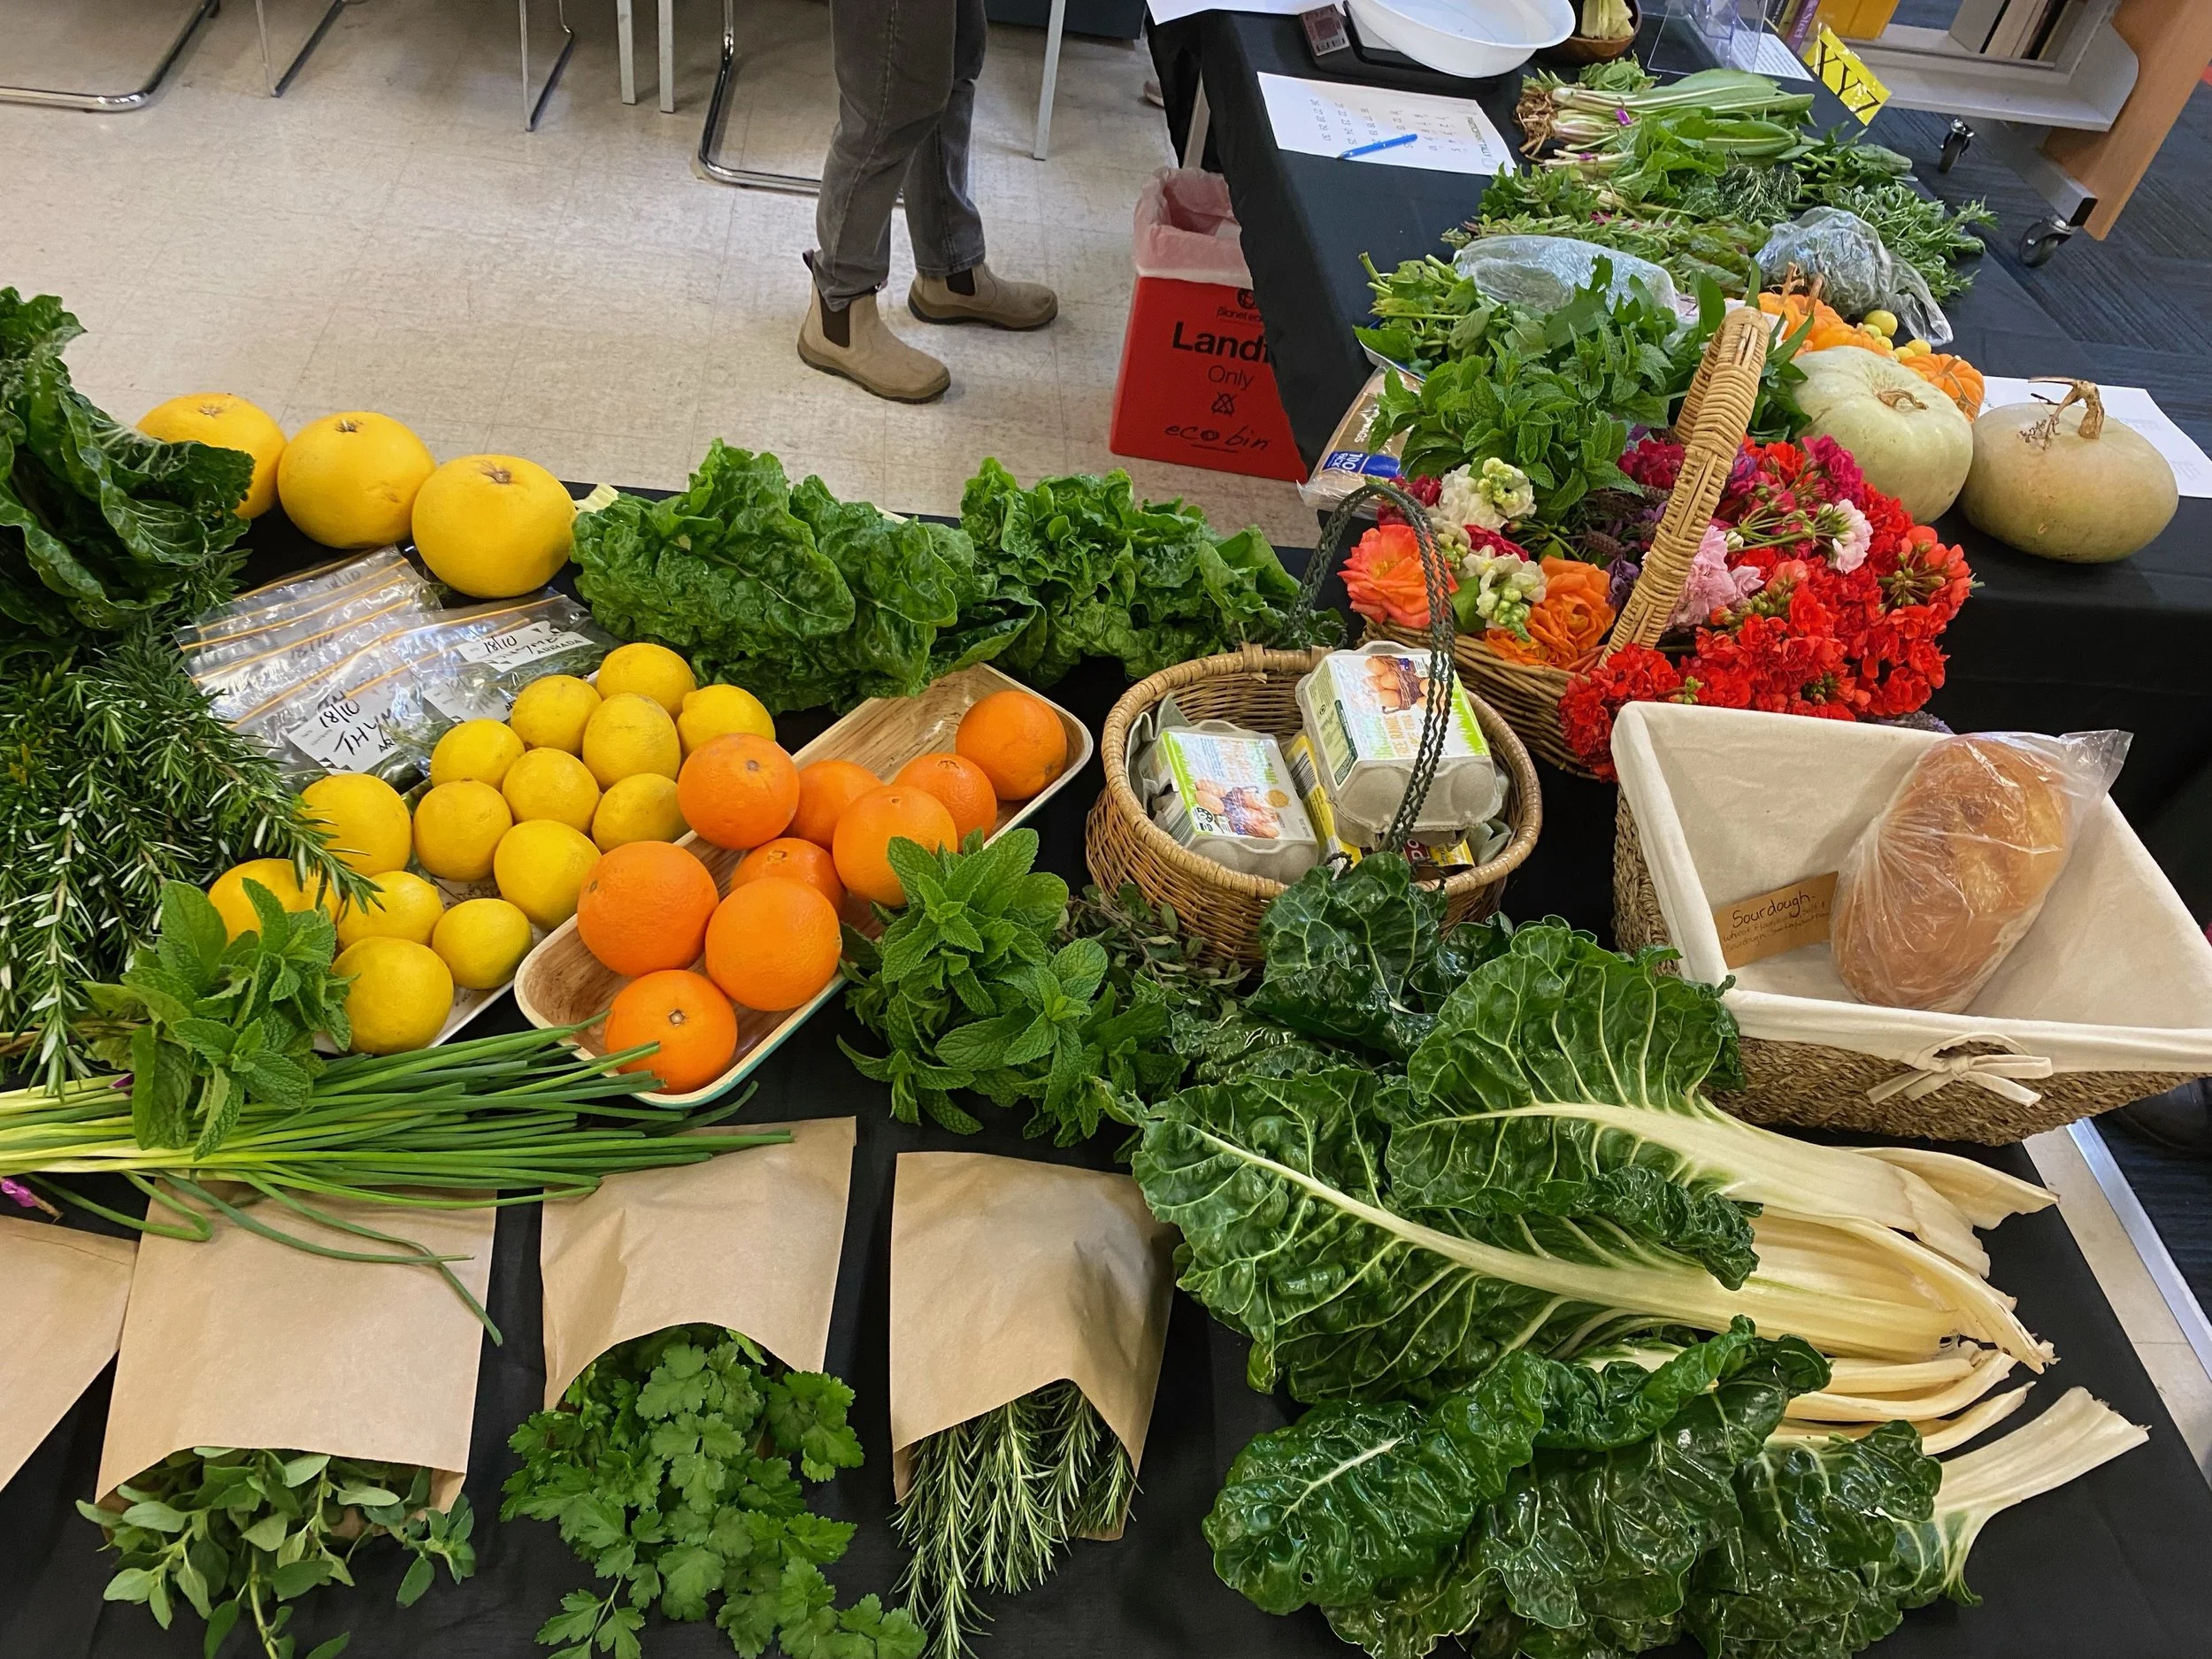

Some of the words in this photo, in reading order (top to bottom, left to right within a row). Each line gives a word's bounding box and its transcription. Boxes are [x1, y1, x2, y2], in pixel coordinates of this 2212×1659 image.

[1208, 365, 1255, 390] Only
[1331, 453, 1348, 467] PACK
[1342, 453, 1363, 470] 100
[484, 635, 518, 655] 18/10
[537, 639, 583, 656] ARMADA
[319, 698, 360, 728] 18/10
